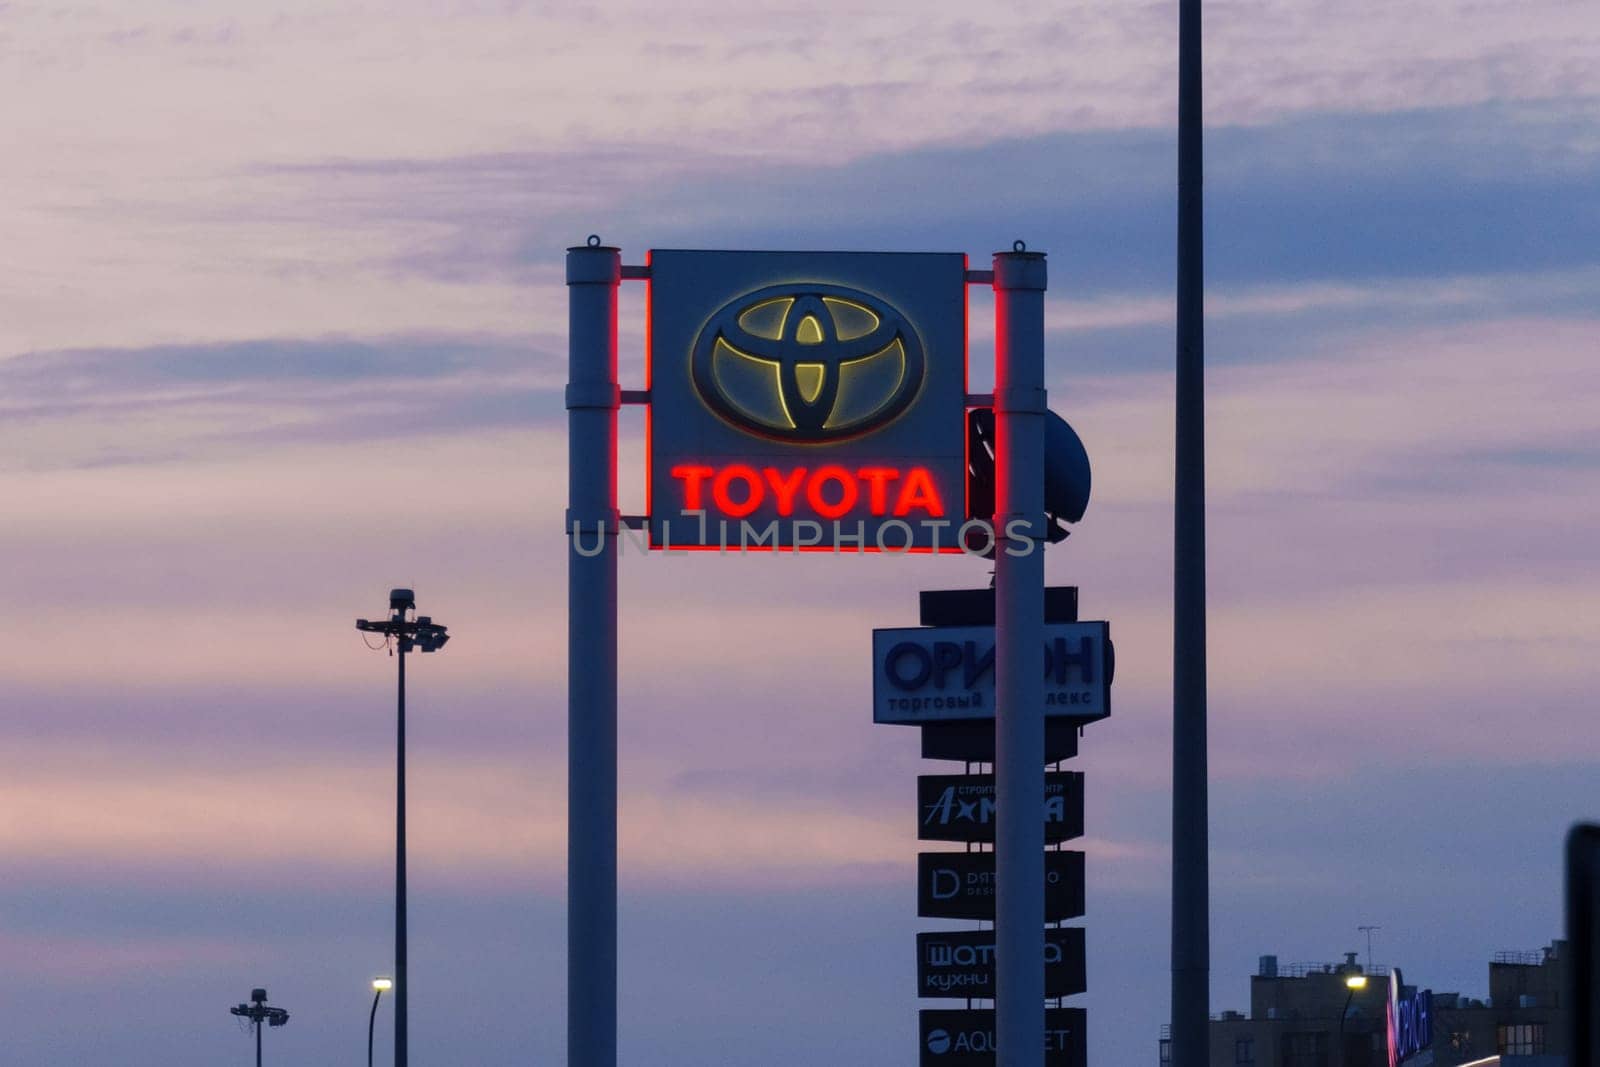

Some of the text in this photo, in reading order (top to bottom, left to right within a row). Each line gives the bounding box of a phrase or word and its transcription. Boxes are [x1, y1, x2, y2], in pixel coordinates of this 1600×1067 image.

[671, 465, 944, 518] TOYOTA
[885, 636, 1094, 691] ОРИН
[887, 692, 983, 713] торговый
[927, 973, 989, 992] кухни
